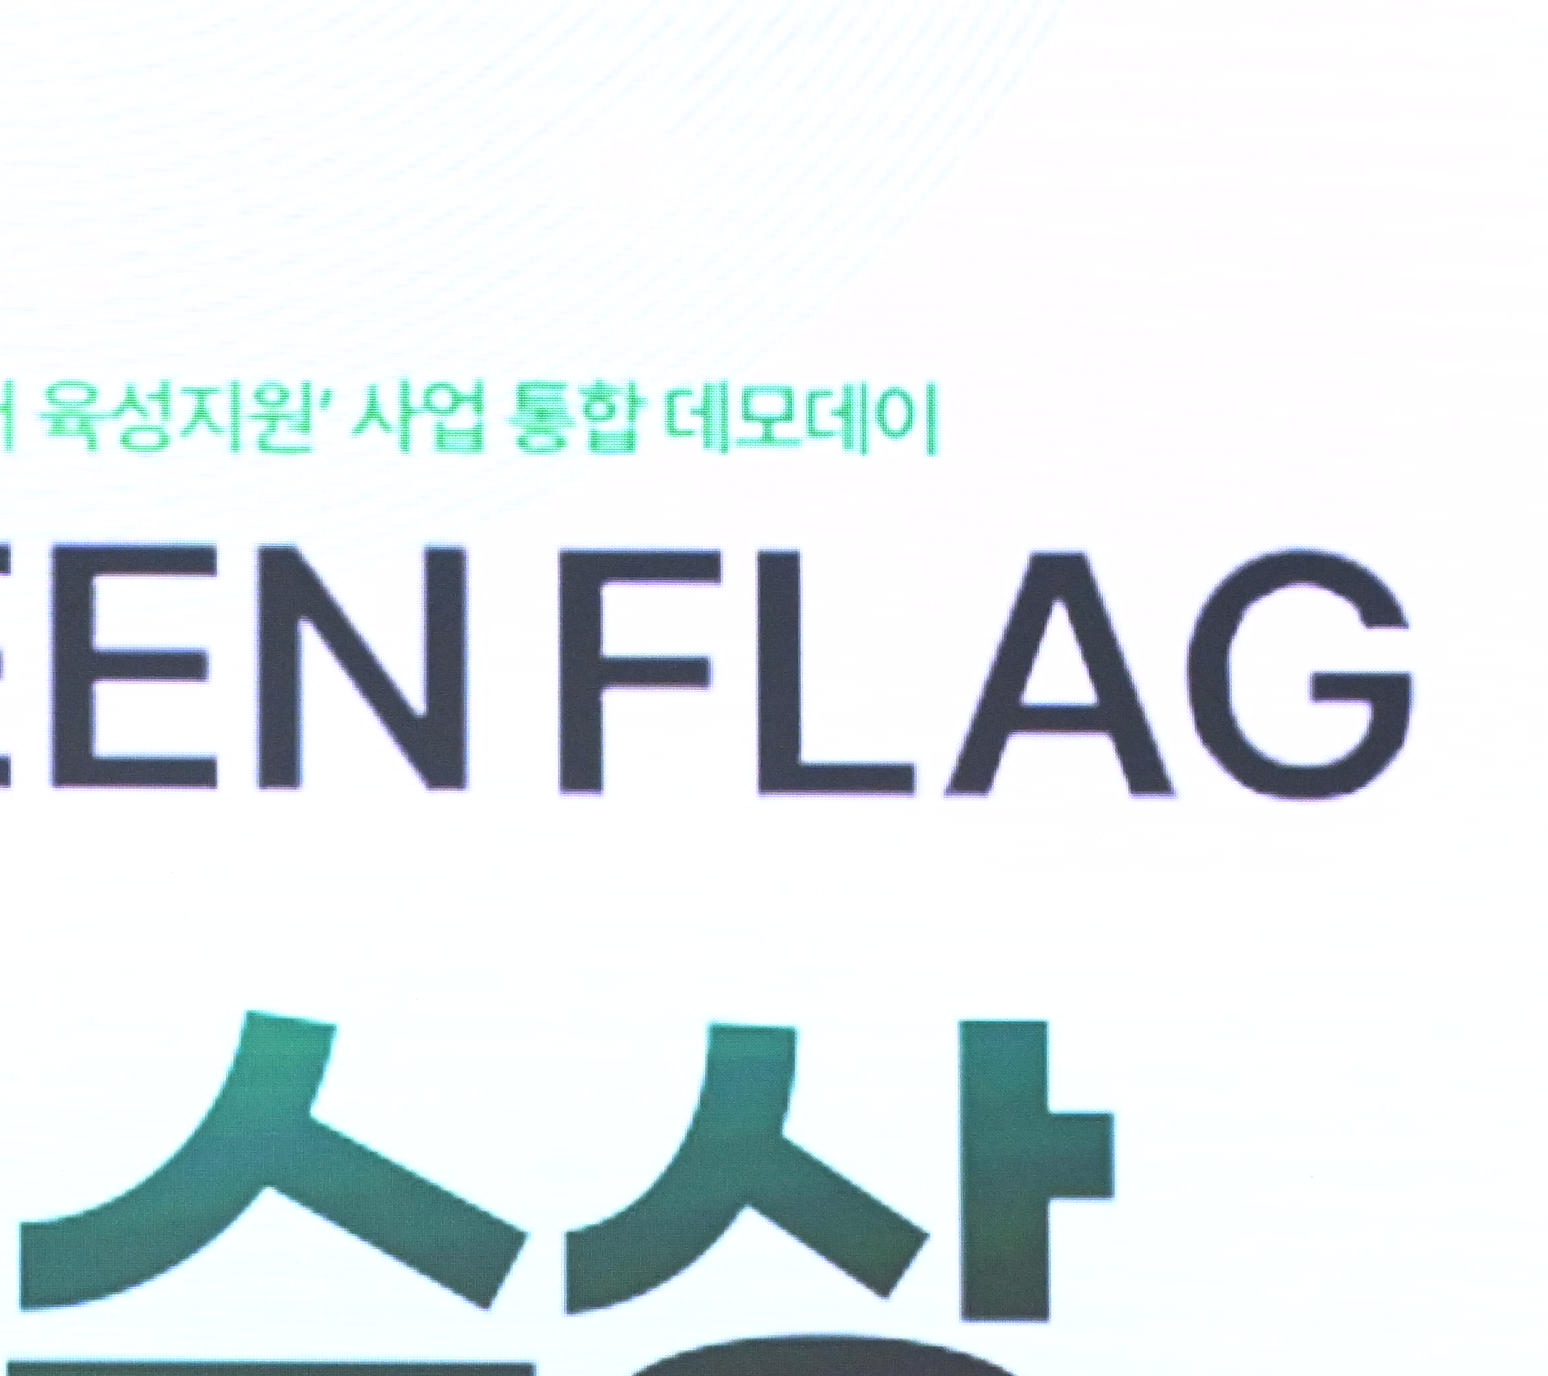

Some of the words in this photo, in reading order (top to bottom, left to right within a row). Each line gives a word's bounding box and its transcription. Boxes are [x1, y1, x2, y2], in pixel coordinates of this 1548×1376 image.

[352, 378, 485, 454] 사업
[509, 379, 648, 455] 통합
[664, 380, 938, 456] 데모데이
[558, 548, 1413, 801] FLAG
